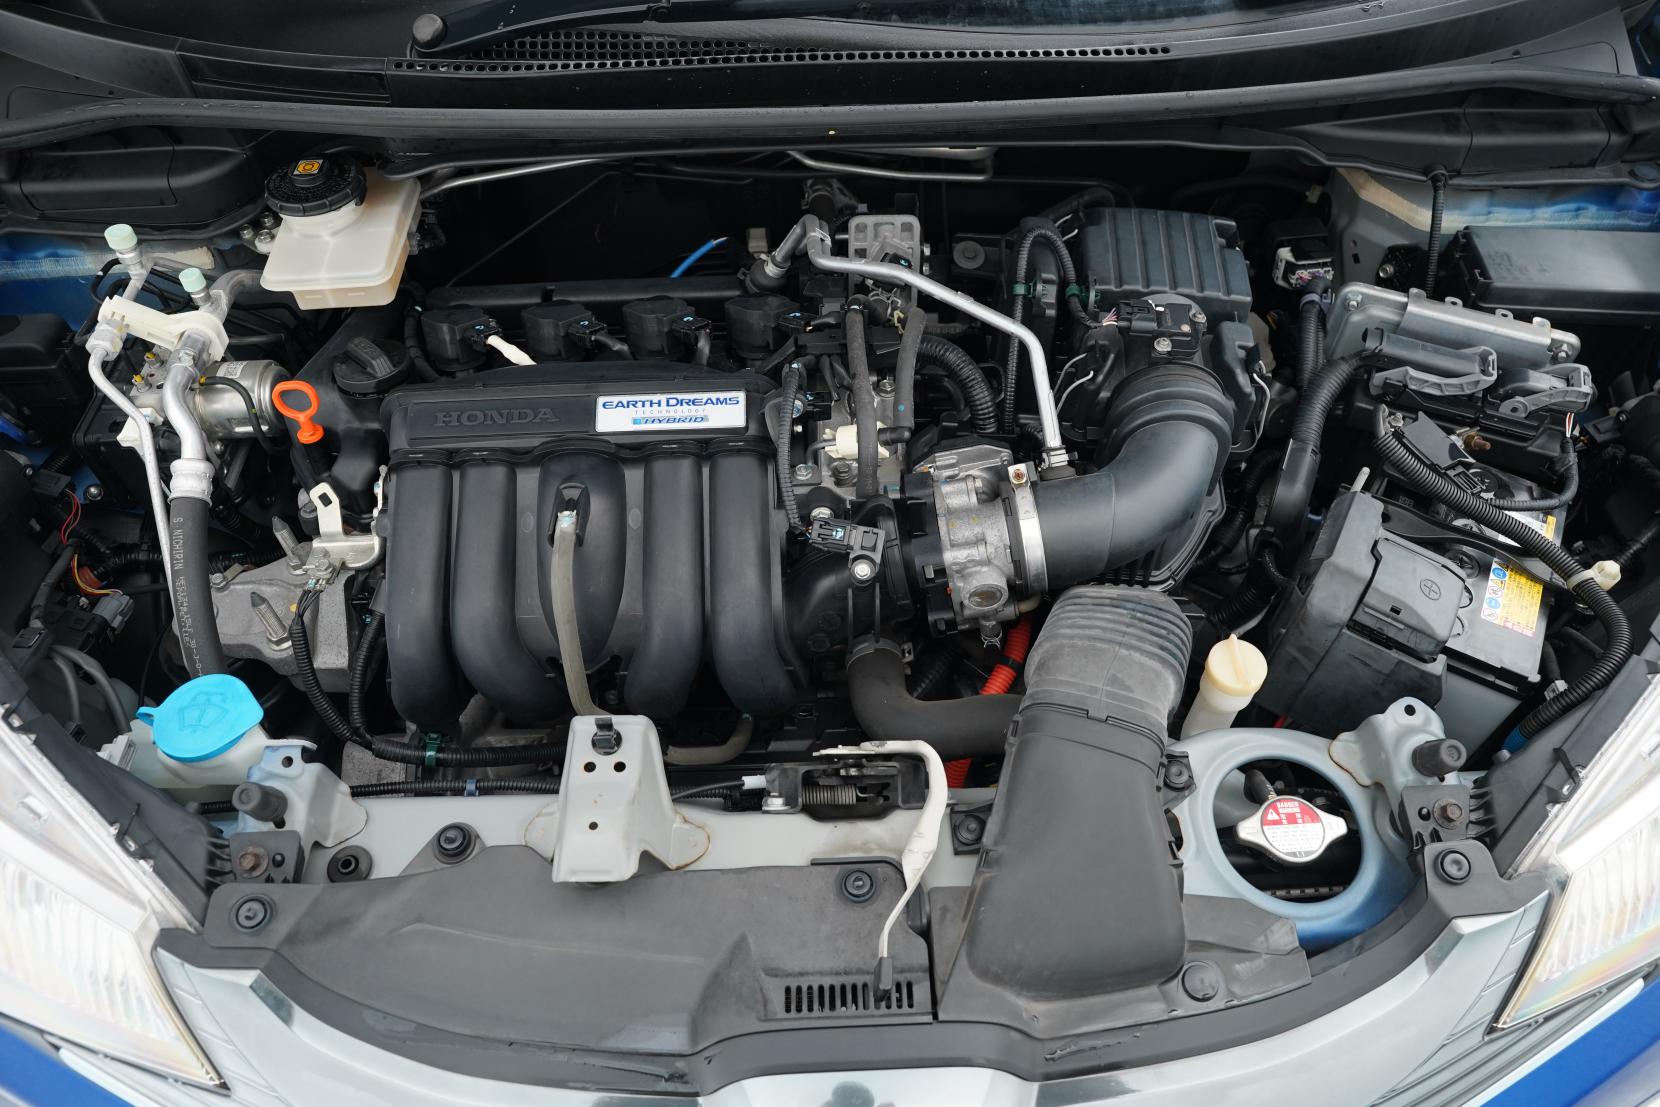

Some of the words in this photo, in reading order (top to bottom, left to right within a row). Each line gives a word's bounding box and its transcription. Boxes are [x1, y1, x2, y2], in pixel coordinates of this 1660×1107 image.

[602, 399, 661, 409] EARTH
[666, 396, 740, 407] DREAMS
[433, 407, 561, 428] HONDA
[644, 416, 705, 425] HYBRID
[172, 529, 185, 570] NICHIRIN
